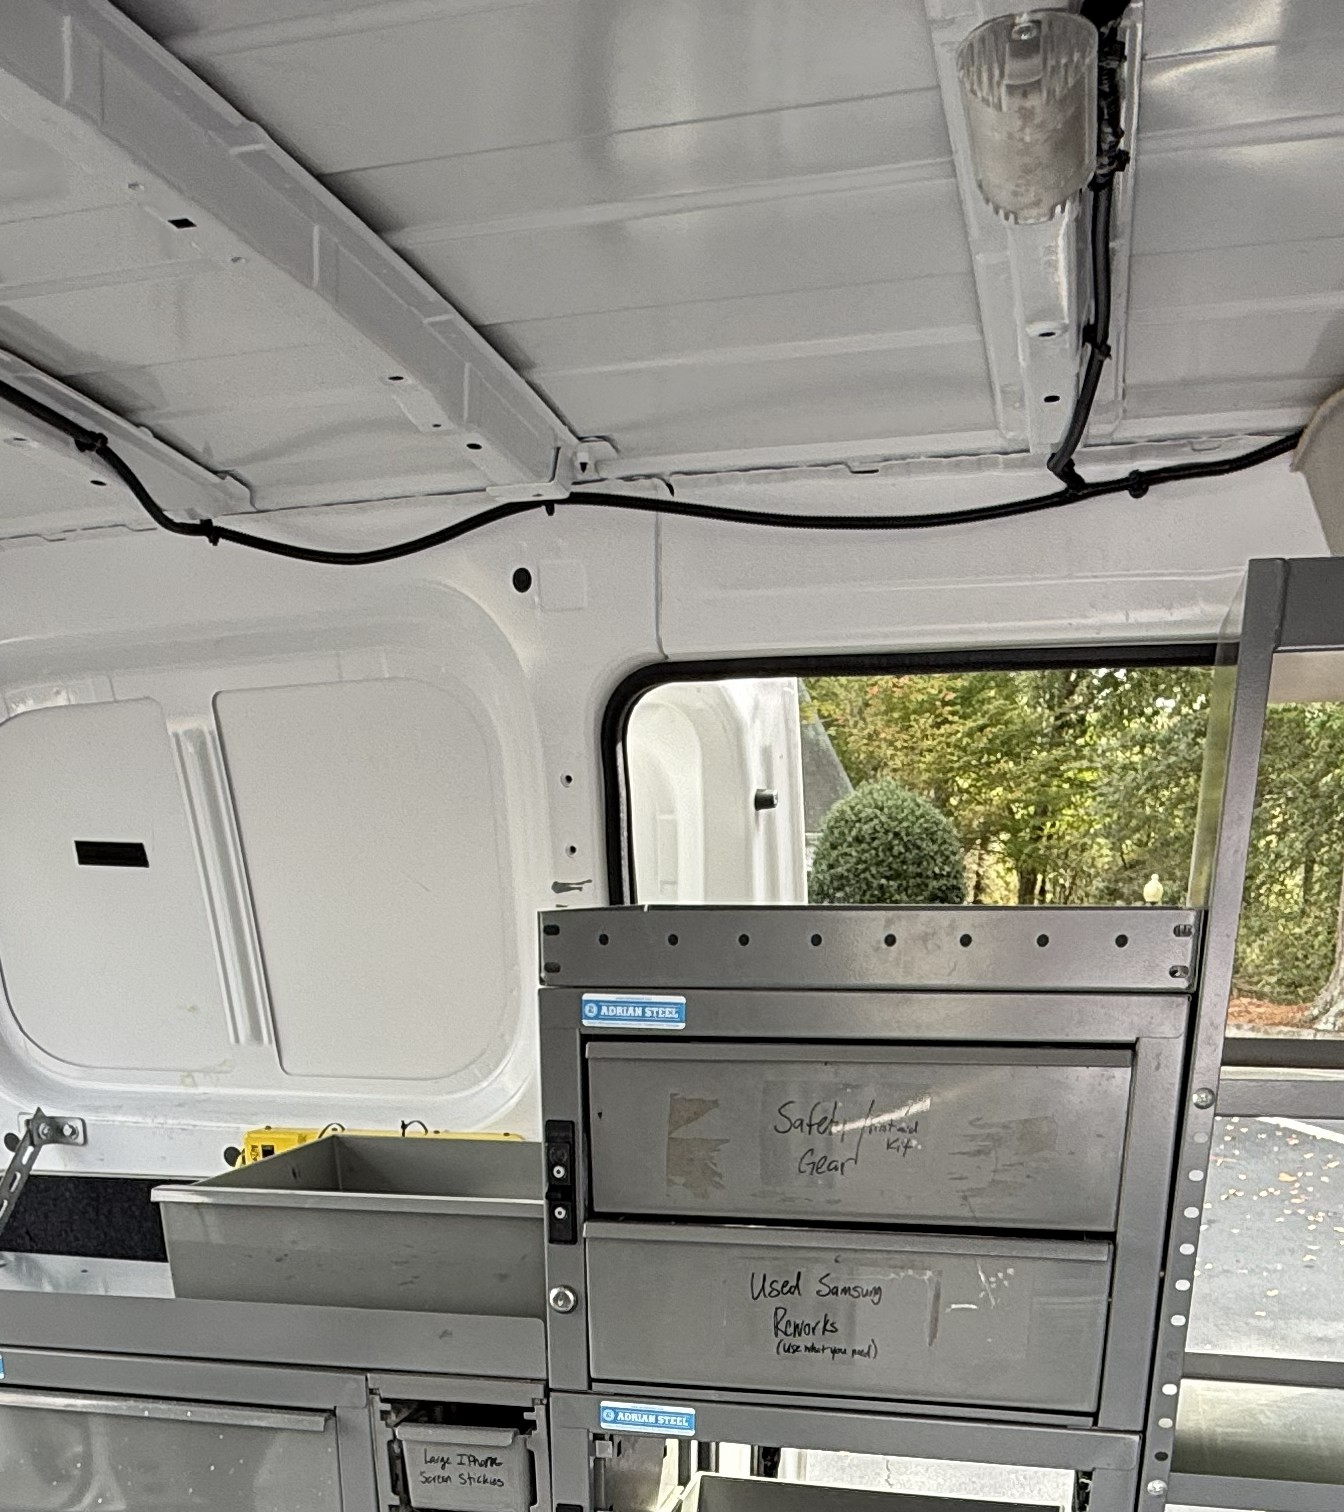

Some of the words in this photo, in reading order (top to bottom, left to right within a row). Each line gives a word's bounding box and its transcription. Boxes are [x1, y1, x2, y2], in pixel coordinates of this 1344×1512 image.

[600, 1005, 642, 1017] ADRIAN
[644, 1007, 679, 1019] STEEL
[798, 1148, 856, 1176] Gear
[750, 1271, 802, 1301] Used
[816, 1273, 882, 1305] Samsung
[773, 1306, 839, 1338] Reworks
[617, 1412, 656, 1424] ADRIAN
[657, 1415, 689, 1427] STEEL
